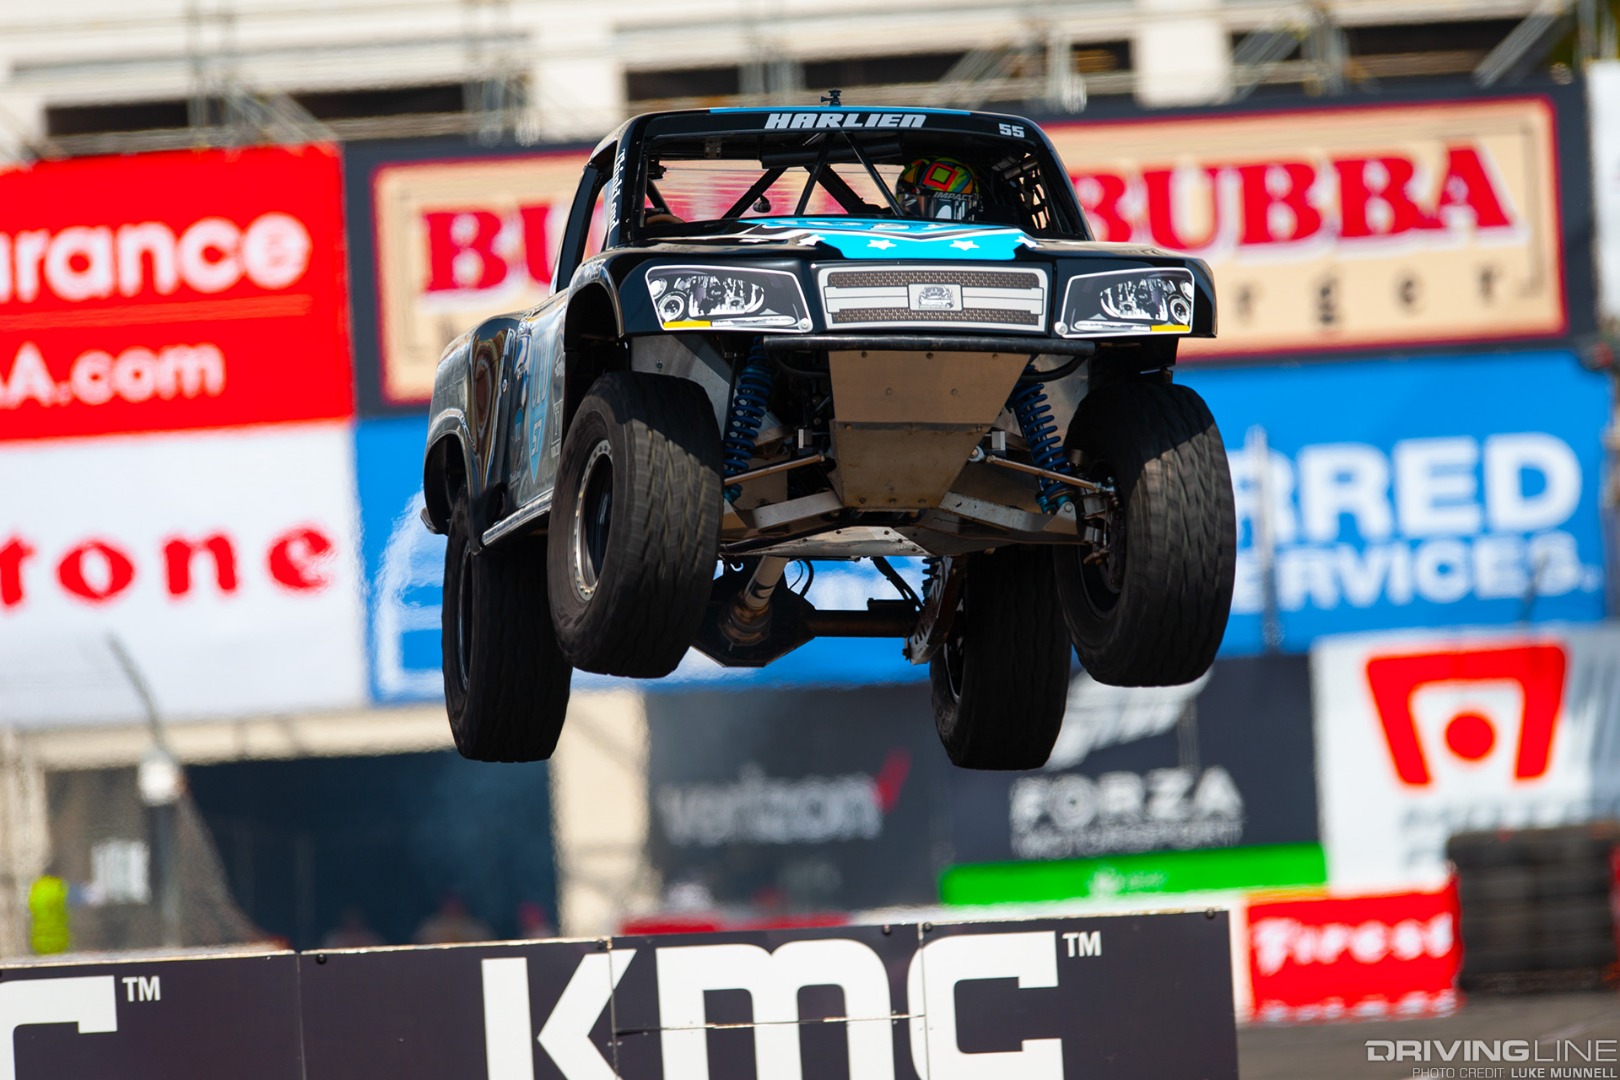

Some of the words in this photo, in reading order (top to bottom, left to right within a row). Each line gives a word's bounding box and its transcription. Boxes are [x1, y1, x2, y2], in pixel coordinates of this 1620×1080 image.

[764, 112, 927, 130] HARLIEN
[998, 122, 1026, 139] 55
[933, 191, 973, 202] IMPACT
[0, 210, 313, 304] rance
[657, 763, 882, 845] verizon
[1009, 767, 1245, 832] FORZA
